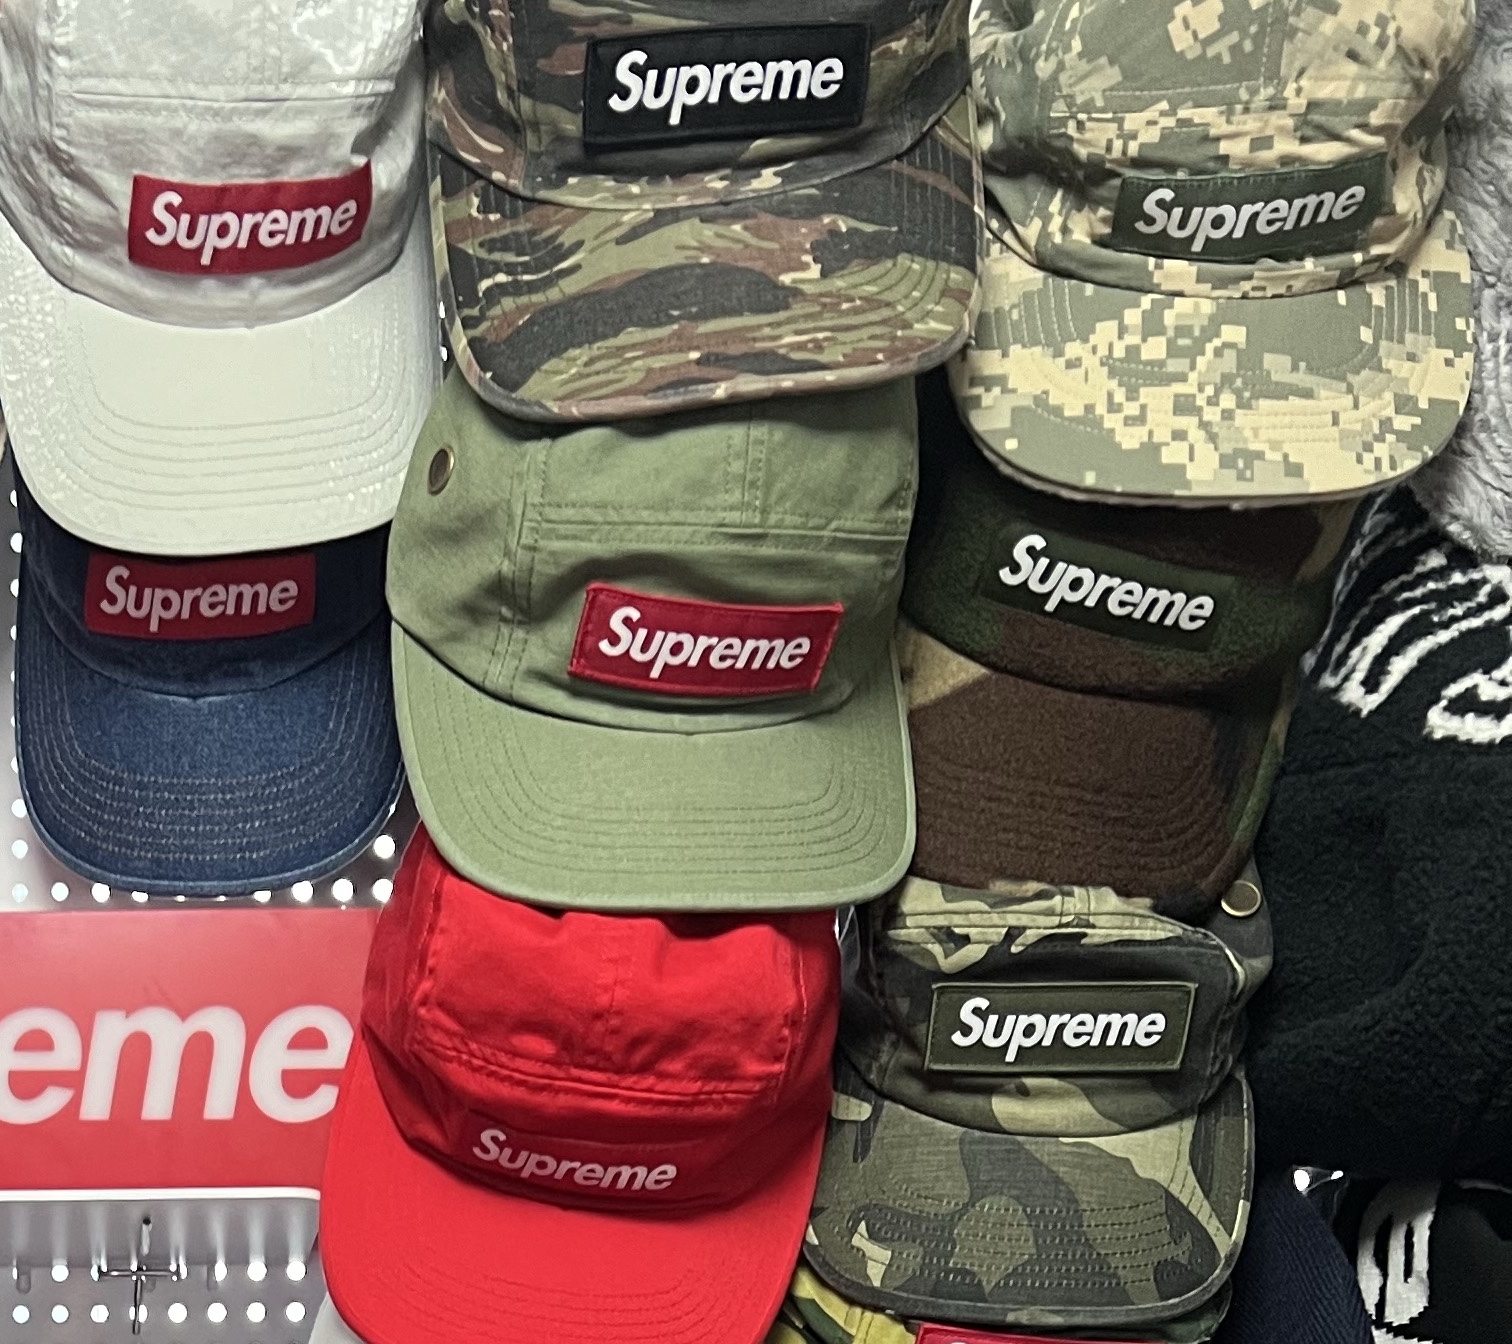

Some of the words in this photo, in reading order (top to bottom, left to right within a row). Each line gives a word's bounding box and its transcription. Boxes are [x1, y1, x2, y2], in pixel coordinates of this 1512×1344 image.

[608, 50, 844, 125] Supreme
[145, 190, 357, 266] Supreme
[1134, 185, 1366, 252] Supreme
[100, 564, 298, 632] Supreme
[999, 534, 1215, 630] Supreme
[598, 606, 811, 679] Supreme
[951, 997, 1166, 1061] Supreme
[472, 1129, 677, 1191] Supreme
